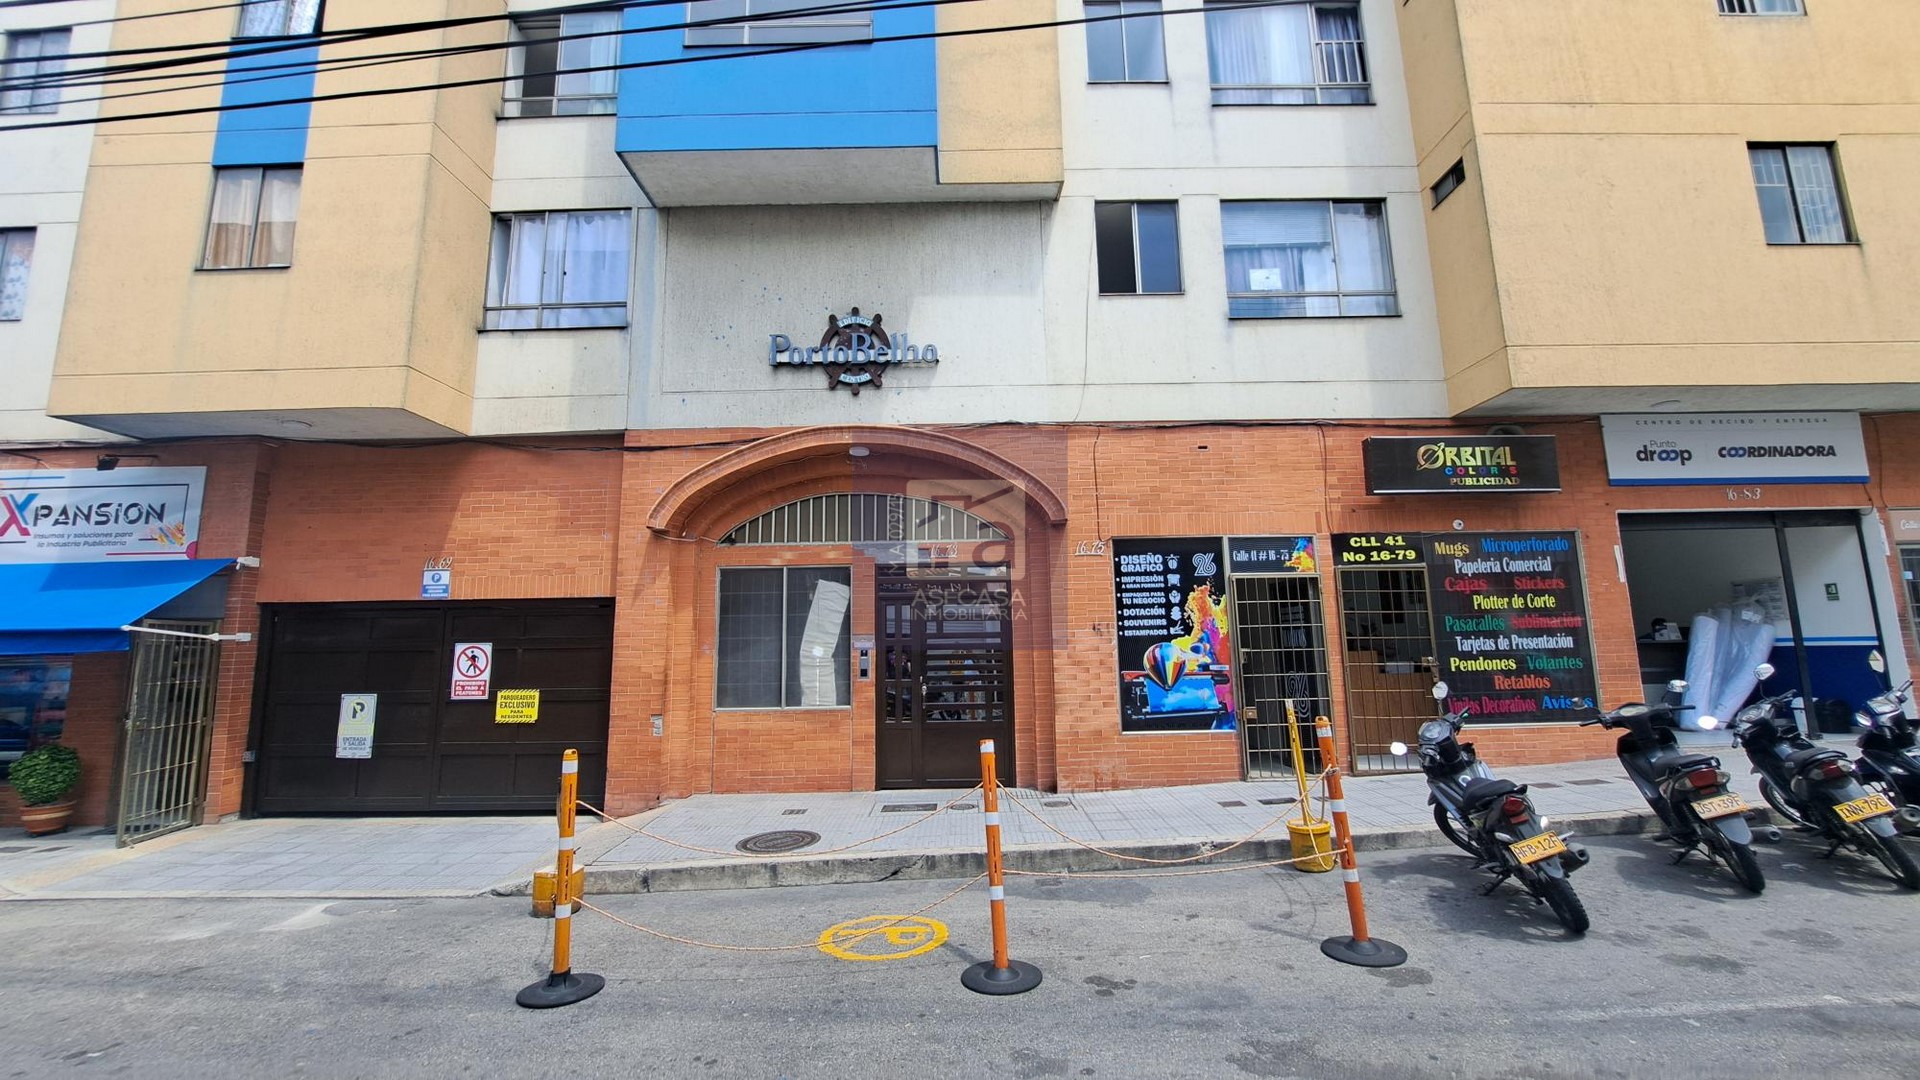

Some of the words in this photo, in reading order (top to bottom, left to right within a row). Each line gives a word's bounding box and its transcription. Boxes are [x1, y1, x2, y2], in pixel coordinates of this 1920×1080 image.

[838, 316, 873, 327] EDIFICIO
[769, 332, 939, 366] PortoBelho
[1650, 440, 1677, 448] Punto
[1636, 444, 1693, 466] droop
[1718, 445, 1837, 458] COORDINADORA
[1450, 476, 1520, 486] PUBLICIDAD
[1349, 536, 1381, 547] CLL
[1384, 535, 1406, 546] 41
[1435, 541, 1470, 557] Mugs
[1481, 536, 1570, 555] Microperforado
[1120, 553, 1163, 565] DISEÑO
[1233, 550, 1249, 561] Calle
[1258, 550, 1267, 561] #
[1268, 550, 1276, 560] 16
[1342, 551, 1366, 562] No
[1370, 549, 1416, 561] 16-79
[1454, 557, 1501, 577] Papeleria
[1502, 556, 1552, 573] Comercial
[1121, 574, 1164, 583] IMPRESIÓN
[1444, 576, 1488, 593] Cajas
[1513, 576, 1566, 590] Stickers
[1473, 594, 1508, 610] Plotter
[1511, 594, 1525, 608] de
[1526, 593, 1556, 607] Corte
[1123, 606, 1166, 616] DOTACIÓN
[1123, 619, 1167, 627] SOUVENIRS
[1445, 615, 1505, 632] Pasacalles
[1455, 635, 1496, 654] Tarjetas
[1497, 635, 1509, 650] de
[1511, 633, 1574, 650] Presentación
[1449, 656, 1517, 672] Pendones
[1526, 656, 1584, 670] Volantes
[1494, 674, 1551, 690] Retablos
[499, 701, 535, 709] EXCLUSIVO
[1482, 695, 1537, 714] Decorativos
[1542, 695, 1594, 710] Aviss
